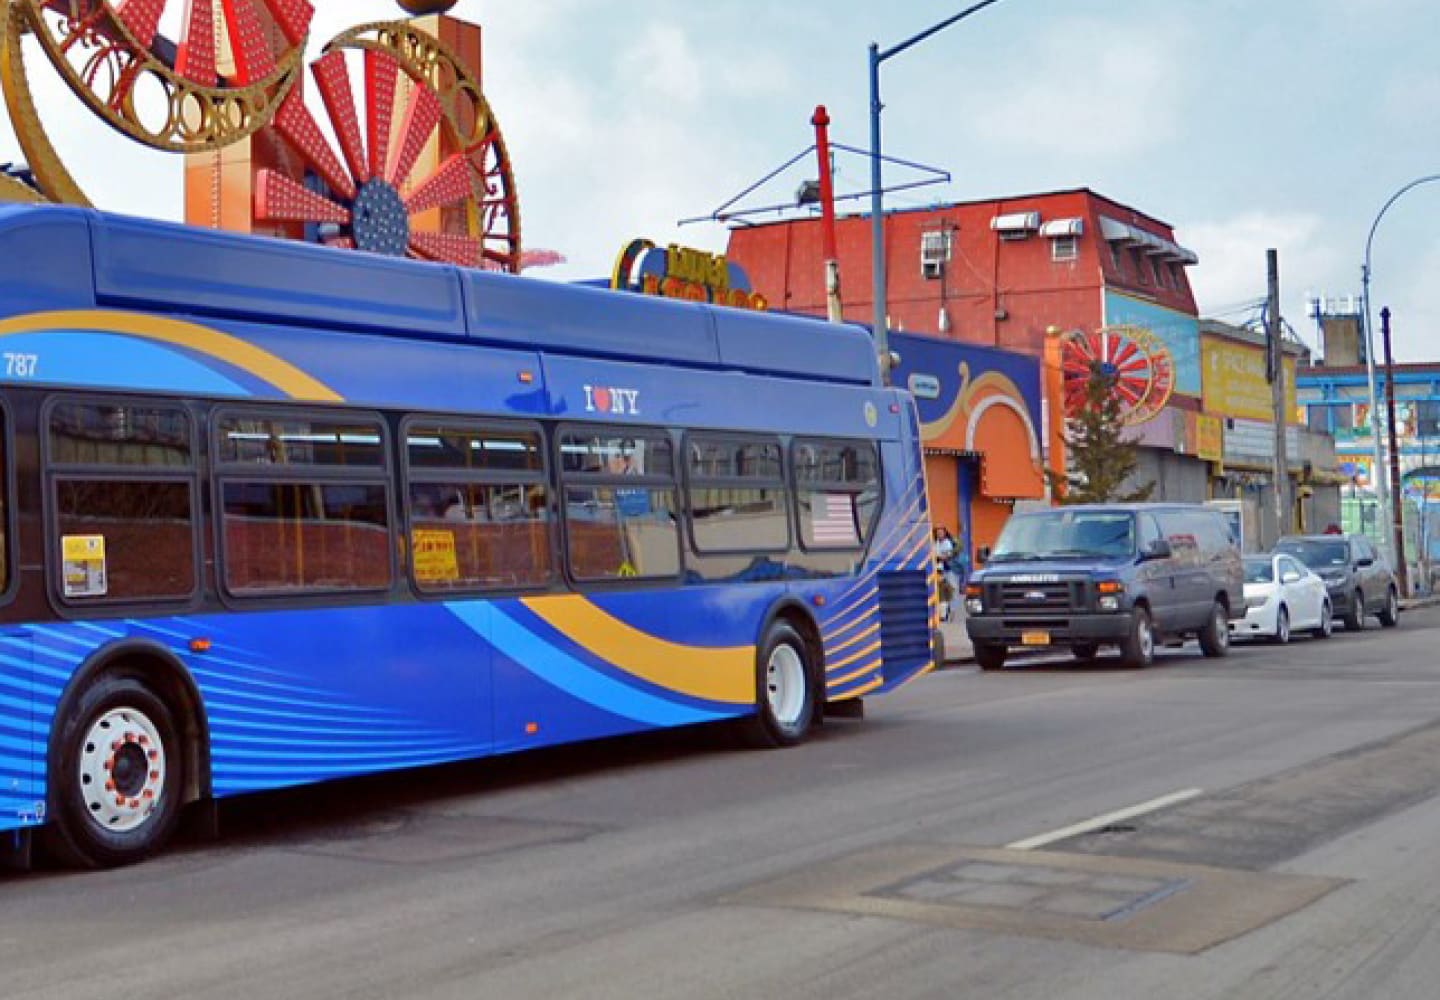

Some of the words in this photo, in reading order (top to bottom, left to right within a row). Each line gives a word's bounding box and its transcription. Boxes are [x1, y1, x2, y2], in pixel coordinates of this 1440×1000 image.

[3, 352, 37, 377] 787
[583, 385, 594, 412] I
[608, 387, 640, 415] NY
